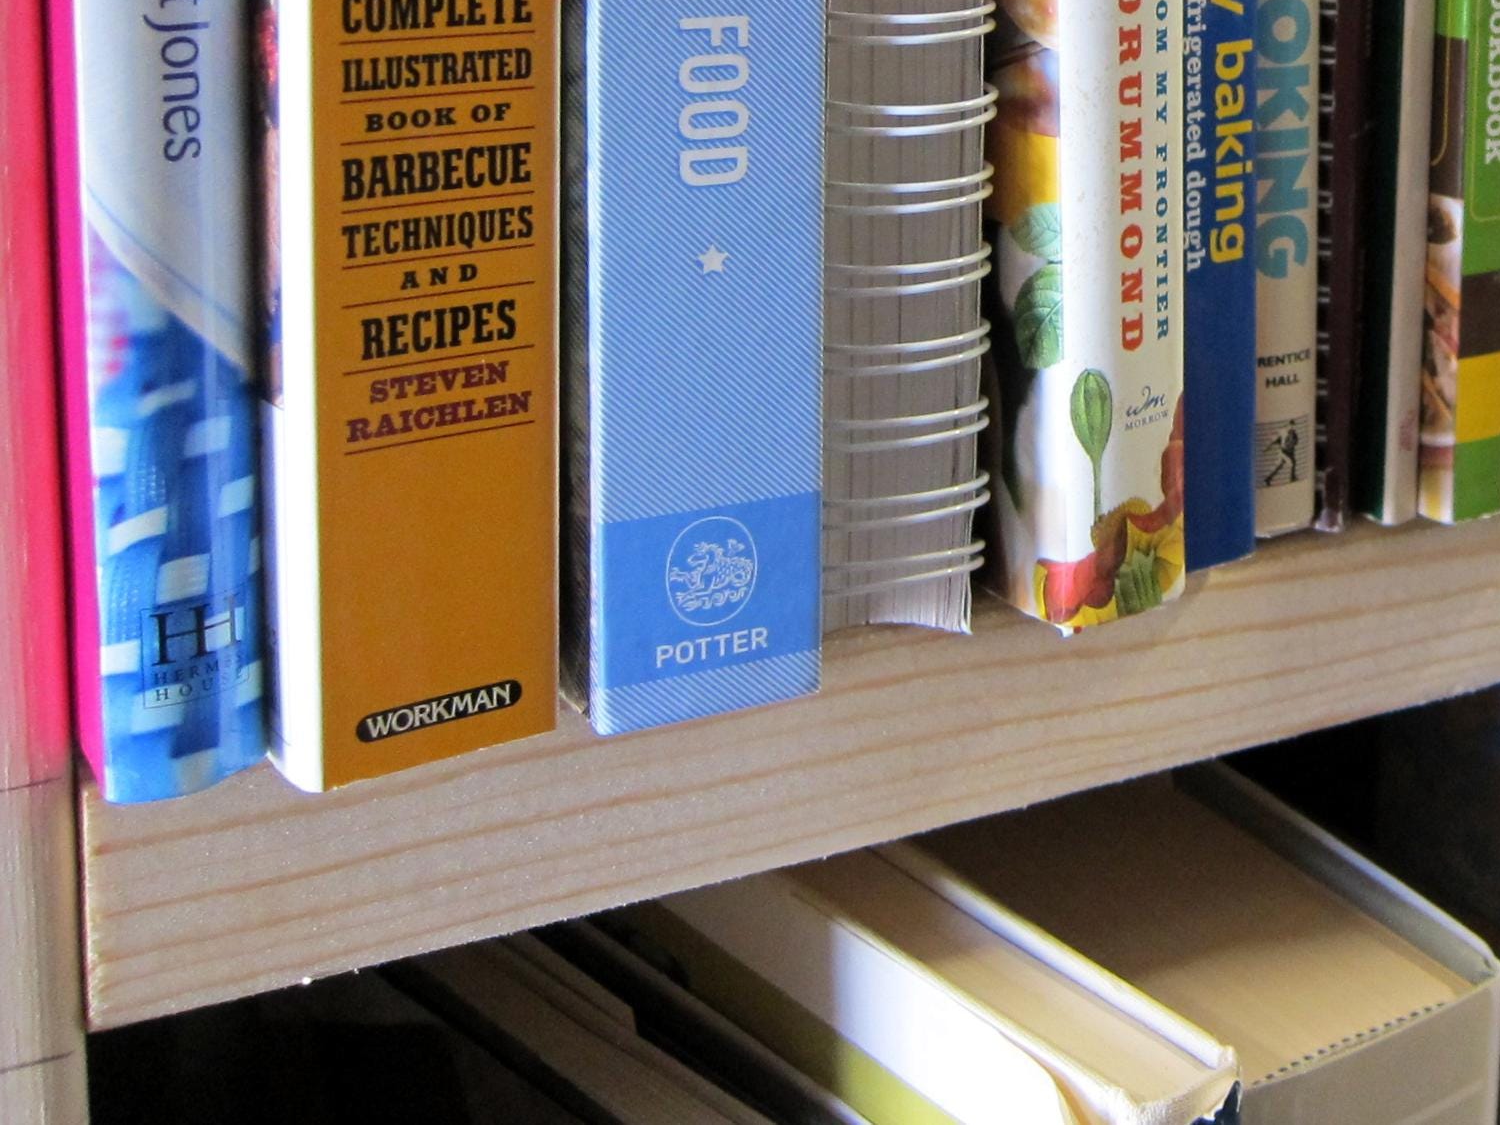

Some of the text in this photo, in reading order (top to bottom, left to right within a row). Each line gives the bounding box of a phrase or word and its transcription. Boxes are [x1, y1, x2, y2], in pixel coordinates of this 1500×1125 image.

[143, 5, 204, 161] Jones
[341, 47, 532, 95] ILLUSTRATED
[1155, 71, 1168, 124] MY
[365, 101, 511, 134] BOOK OF
[680, 15, 750, 187] FOOD
[341, 142, 532, 202] BARBECUE
[1210, 40, 1254, 264] baking
[342, 205, 535, 259] TECHNIQUES
[1155, 143, 1170, 340] FRONTIER
[1181, 169, 1206, 271] dough
[401, 263, 479, 291] AND
[360, 299, 517, 360] RECIPES
[369, 360, 509, 404] STEVEN
[1257, 348, 1311, 368] RENTICE
[1265, 373, 1300, 389] HALL
[346, 391, 532, 444] RAICHLEN
[1124, 409, 1169, 431] MORROW
[655, 625, 769, 669] POTTER
[366, 683, 513, 735] WORKMAN
